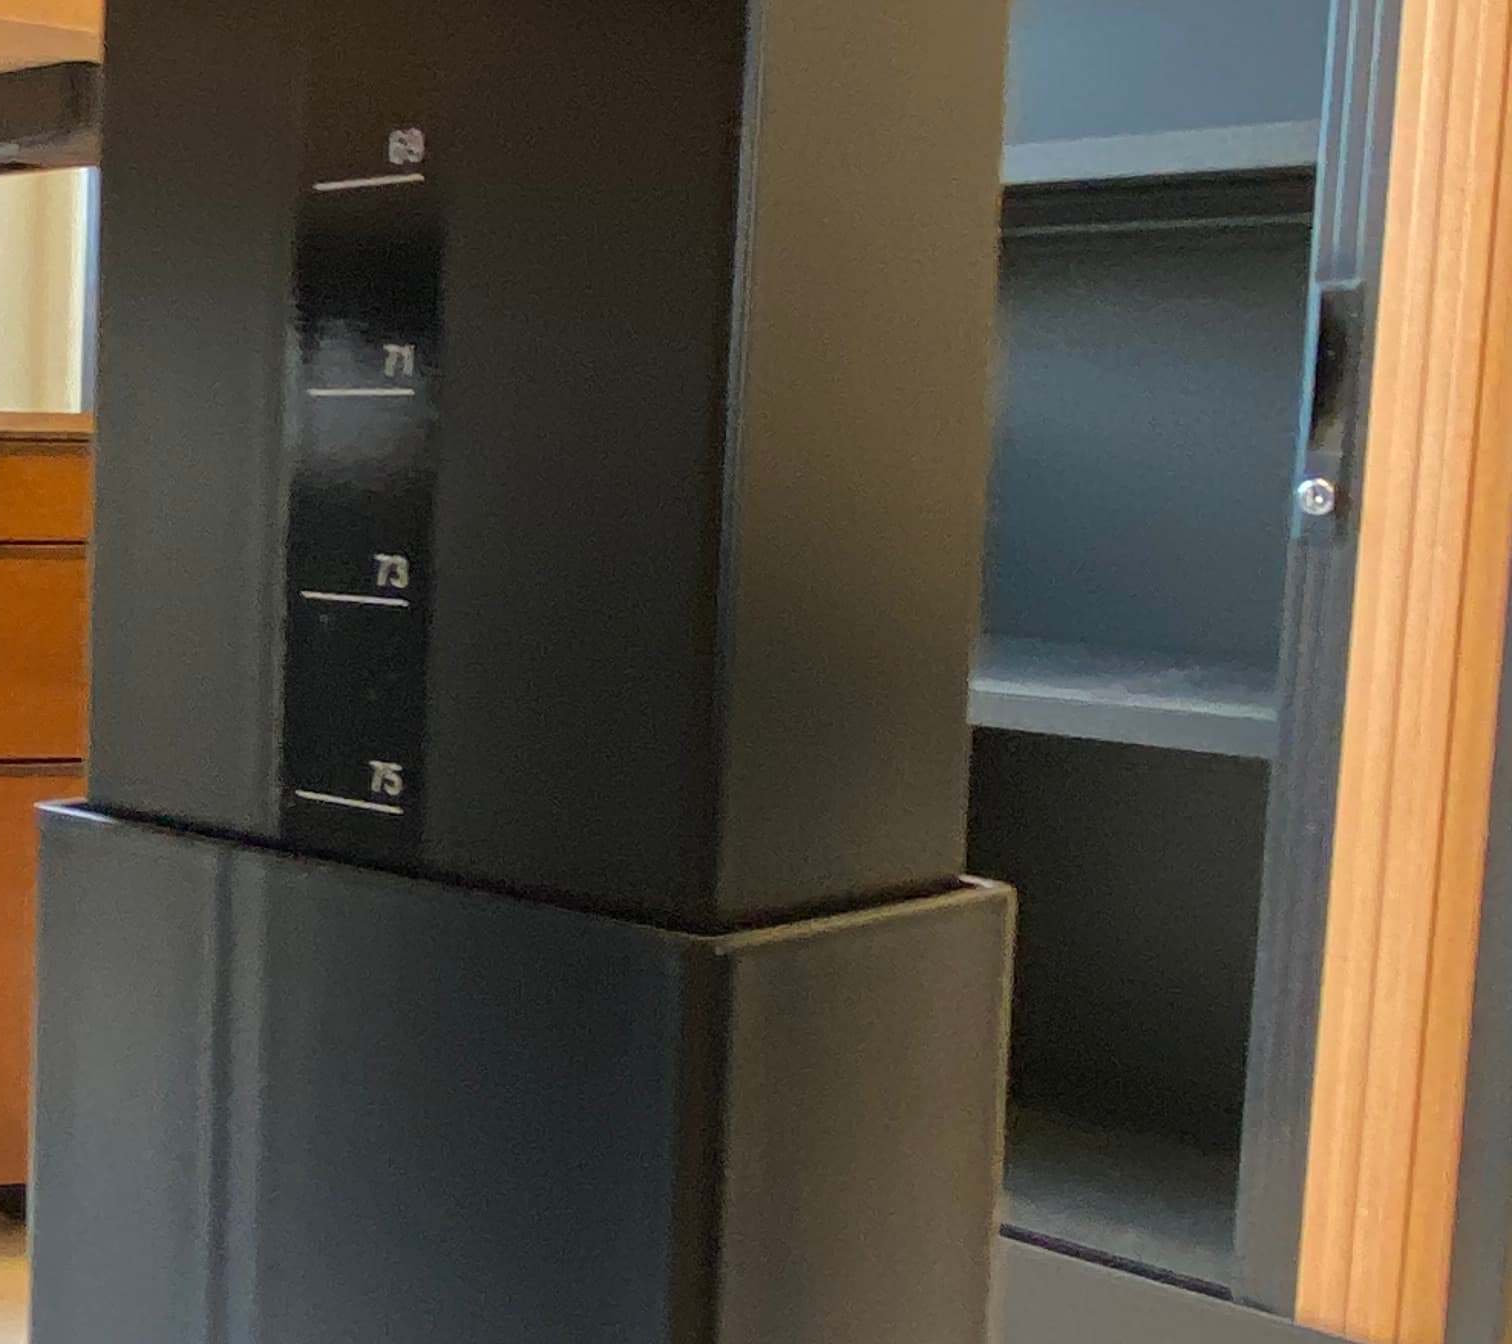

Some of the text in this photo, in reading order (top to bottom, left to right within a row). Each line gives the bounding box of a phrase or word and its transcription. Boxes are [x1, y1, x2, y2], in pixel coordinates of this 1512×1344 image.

[383, 344, 415, 377] 71
[375, 555, 410, 588] 73
[369, 761, 403, 796] 75
